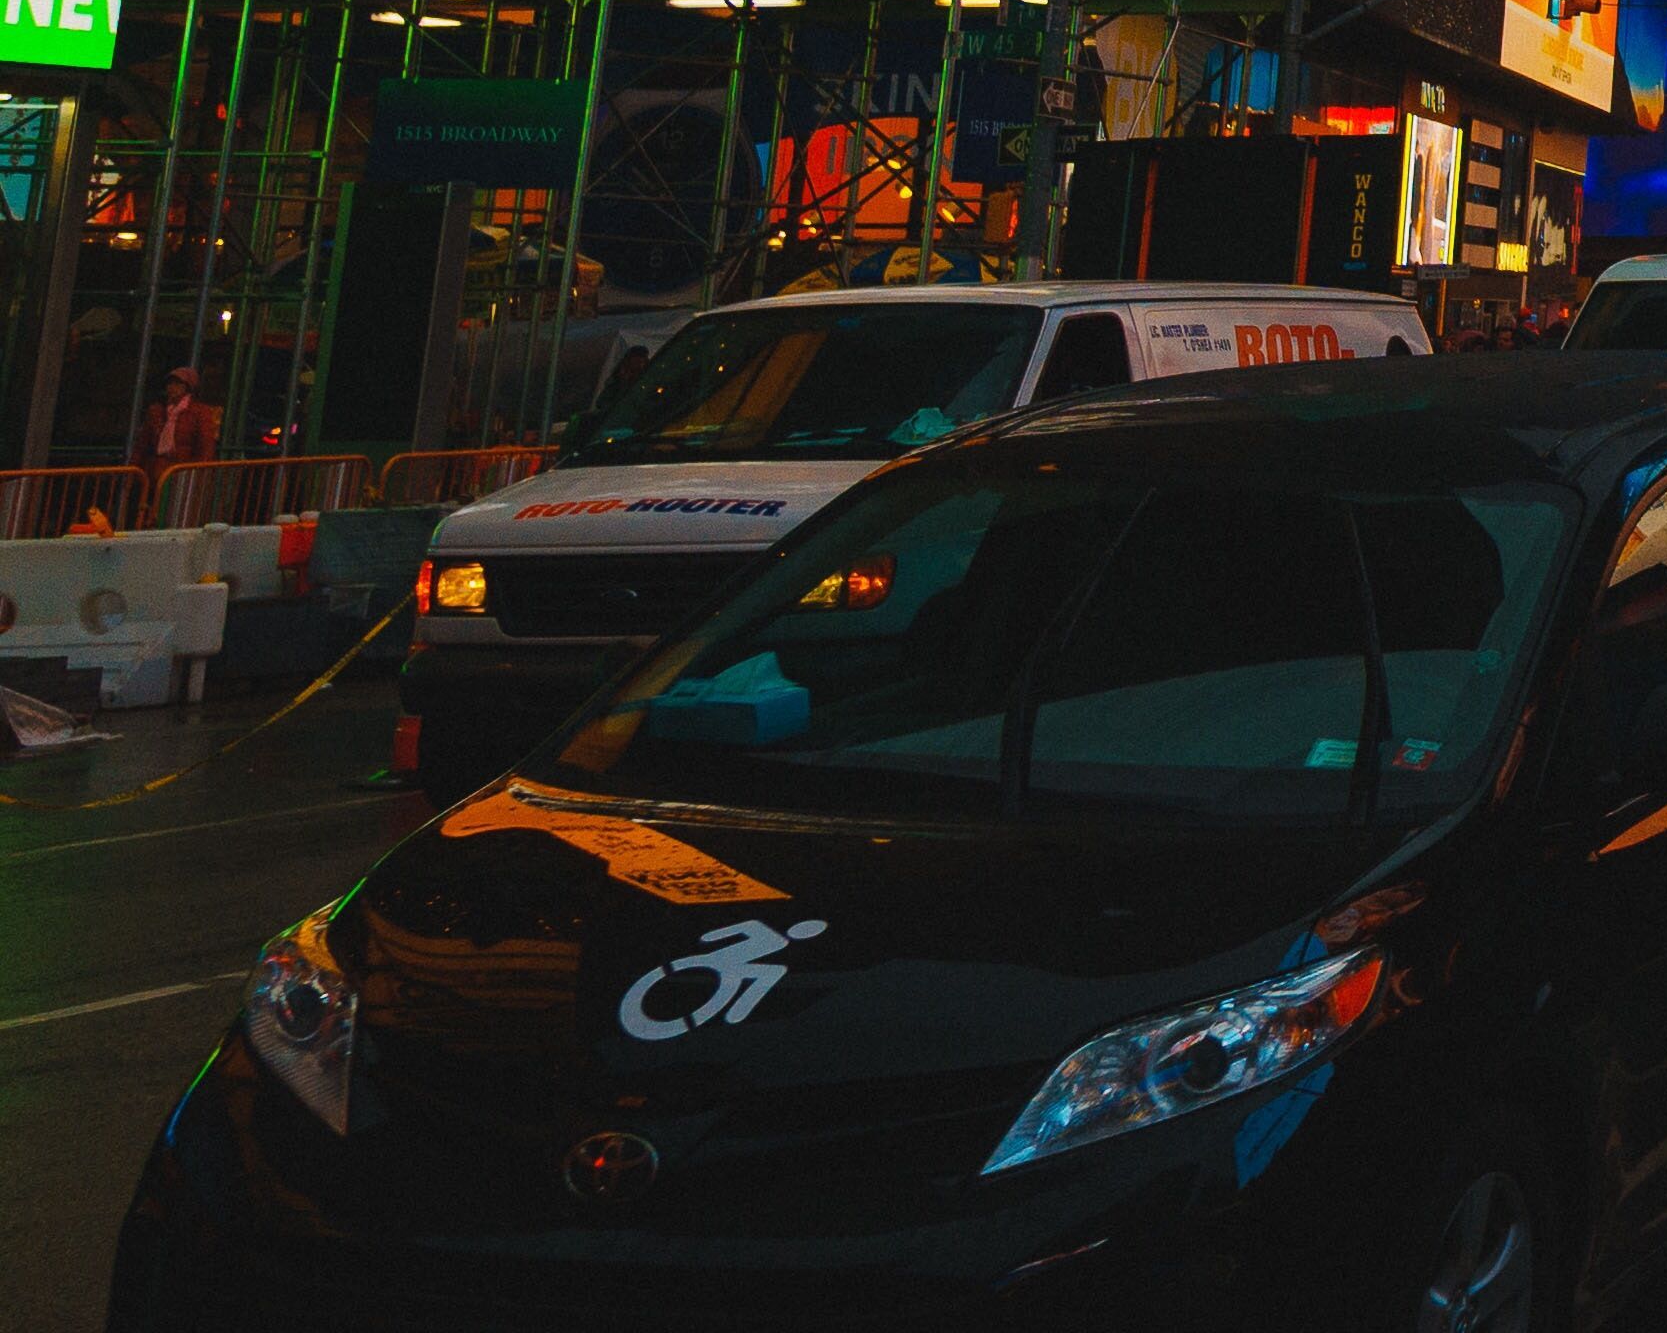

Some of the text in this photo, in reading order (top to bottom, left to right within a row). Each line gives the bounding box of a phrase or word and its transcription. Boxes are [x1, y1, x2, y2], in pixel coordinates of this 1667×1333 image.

[967, 34, 1014, 53] W 45
[440, 125, 563, 143] BROADWAY
[1353, 173, 1371, 259] WANCO
[514, 498, 787, 520] ROTO-ROOTER
